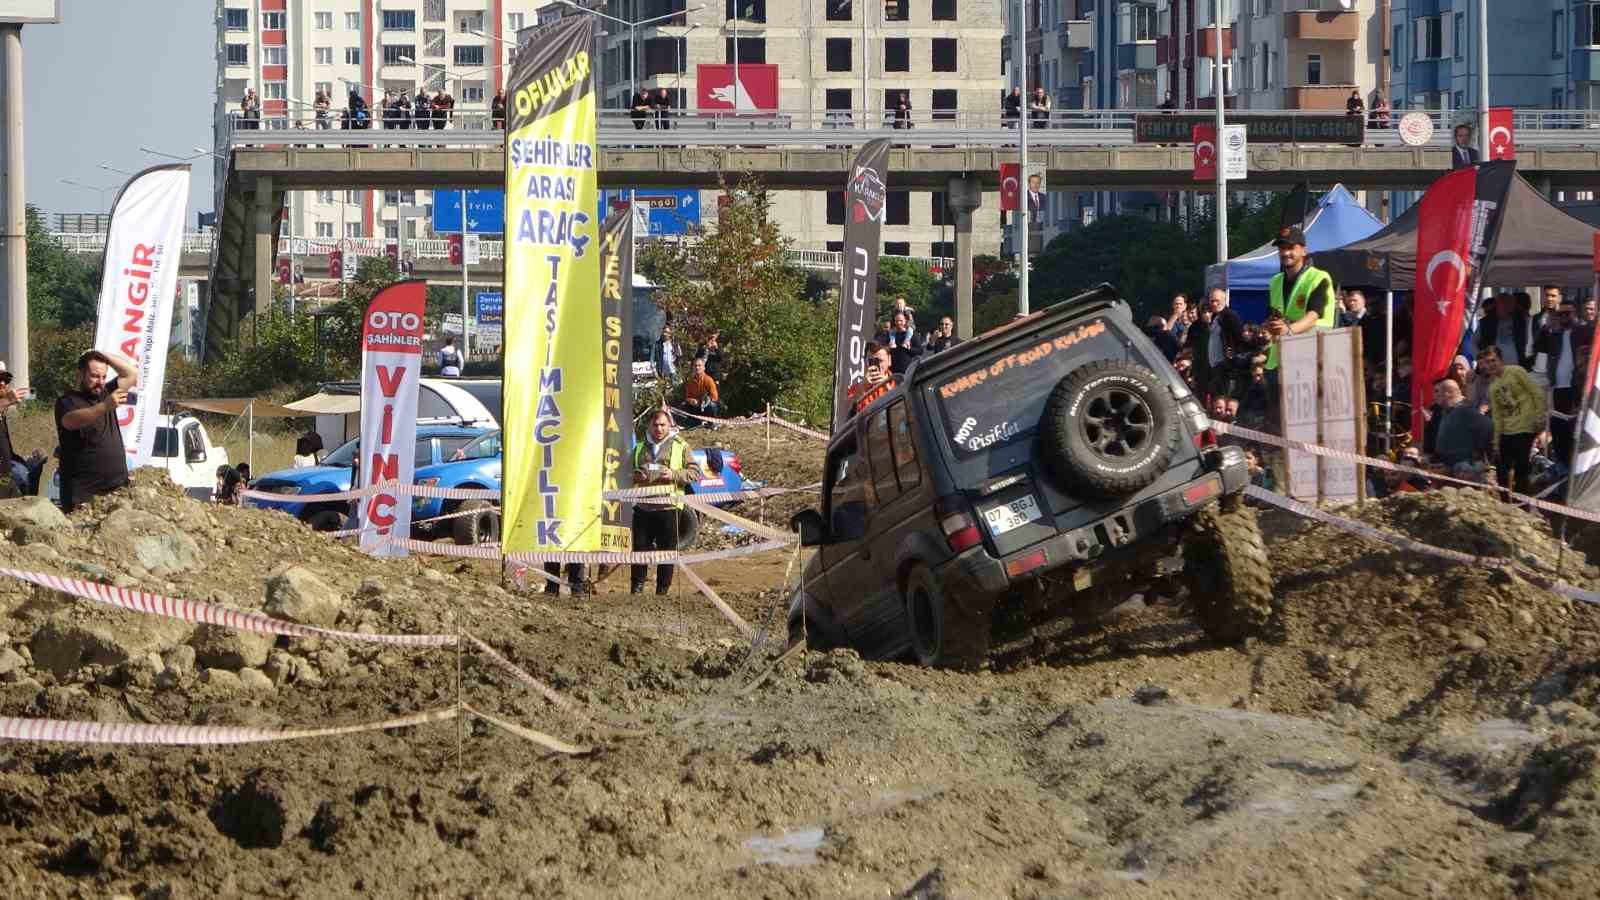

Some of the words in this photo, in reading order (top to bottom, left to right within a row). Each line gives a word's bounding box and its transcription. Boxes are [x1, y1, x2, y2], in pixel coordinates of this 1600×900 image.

[515, 50, 590, 116] OFLULAR
[512, 134, 592, 169] ŞEHİRLER
[527, 175, 575, 201] ARASI
[453, 202, 493, 210] Atvin
[517, 208, 589, 257] ARAÇ
[603, 229, 623, 299] YER
[115, 243, 156, 427] CANGİR
[367, 332, 421, 345] ŞAHİNLER
[369, 311, 420, 331] OTO
[604, 316, 622, 432] SORMA
[990, 354, 1016, 377] OFF
[1017, 342, 1052, 366] ROAD
[534, 256, 564, 545] TAŞIMACILIK
[954, 417, 977, 445] MOTO
[367, 365, 407, 535] VİNÇ
[987, 509, 1001, 522] 07
[1010, 496, 1034, 513] BGJ
